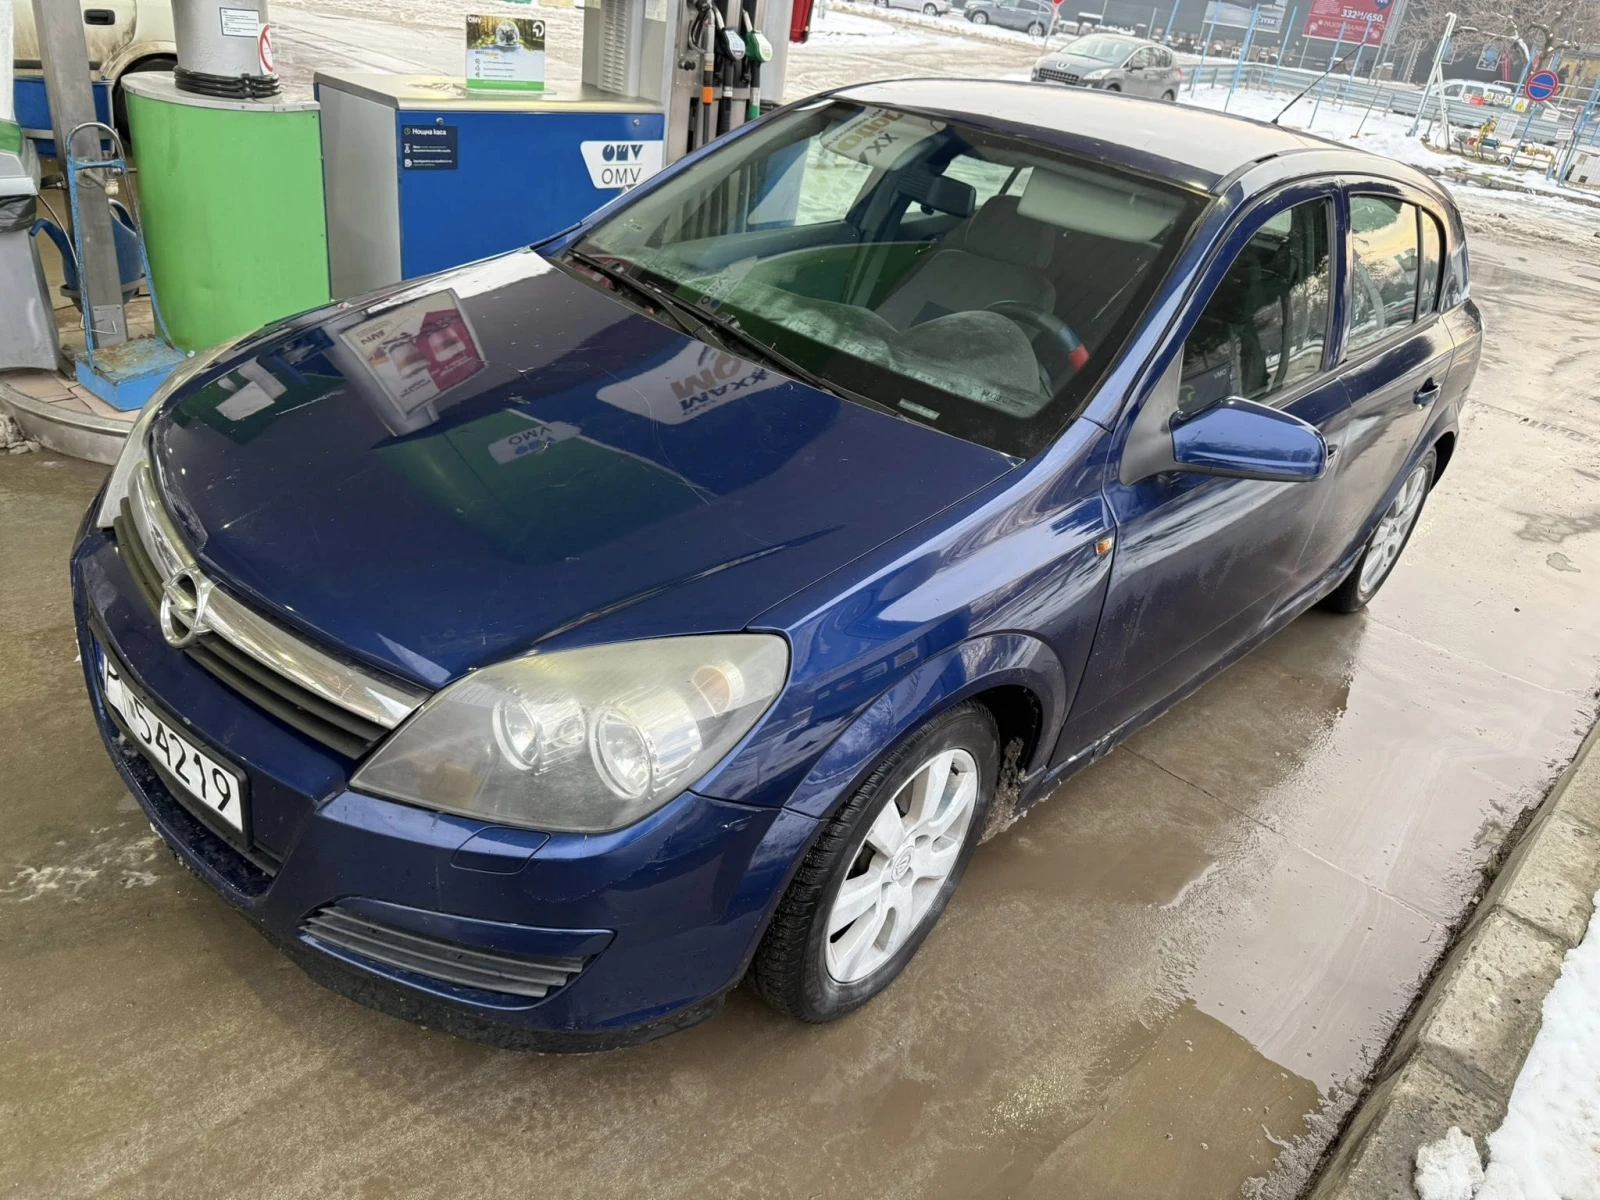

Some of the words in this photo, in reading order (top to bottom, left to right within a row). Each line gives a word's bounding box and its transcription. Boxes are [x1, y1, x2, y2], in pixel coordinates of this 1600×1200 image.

[412, 128, 433, 136] Нощна
[601, 168, 642, 185] OMV
[133, 697, 232, 812] 54219
